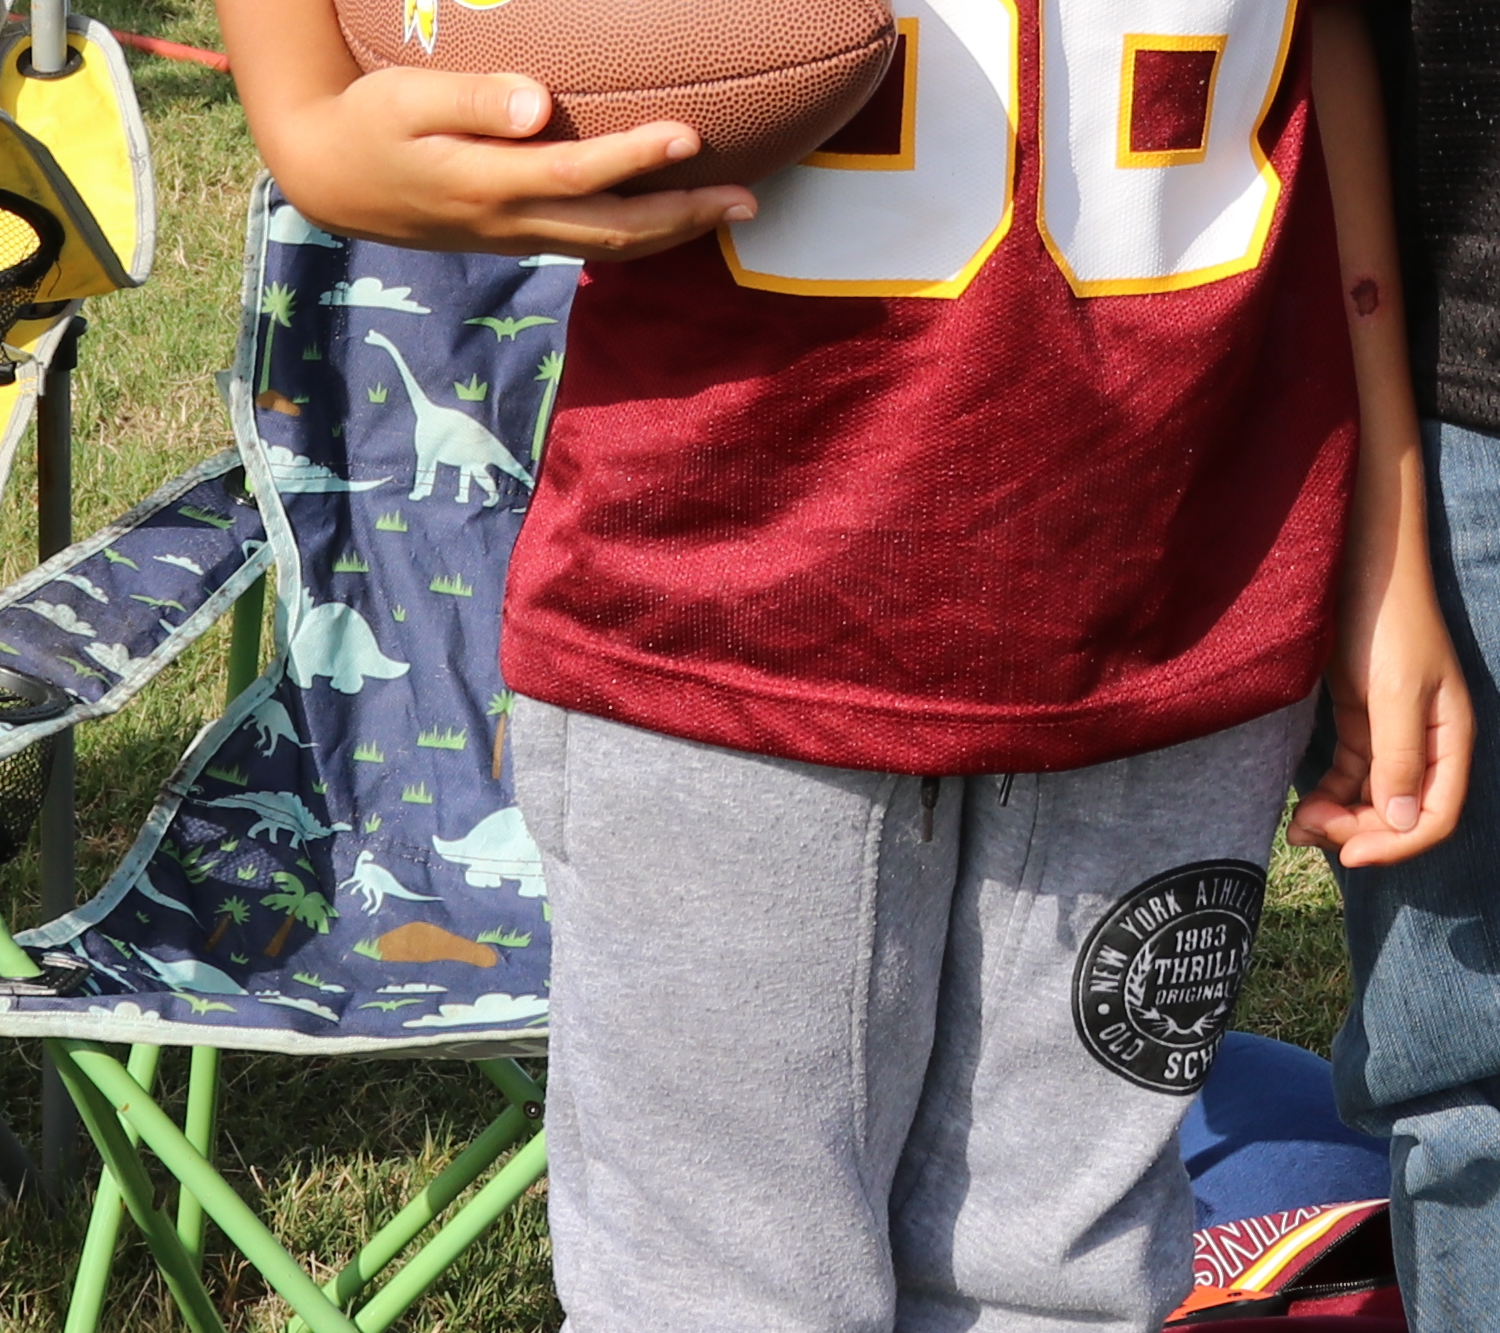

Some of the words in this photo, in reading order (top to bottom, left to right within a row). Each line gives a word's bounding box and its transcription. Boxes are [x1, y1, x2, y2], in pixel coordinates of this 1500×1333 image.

[1090, 944, 1129, 993] NEW
[1119, 889, 1183, 941] YORK
[1175, 924, 1228, 953] 1983
[1099, 1022, 1145, 1061] OLD
